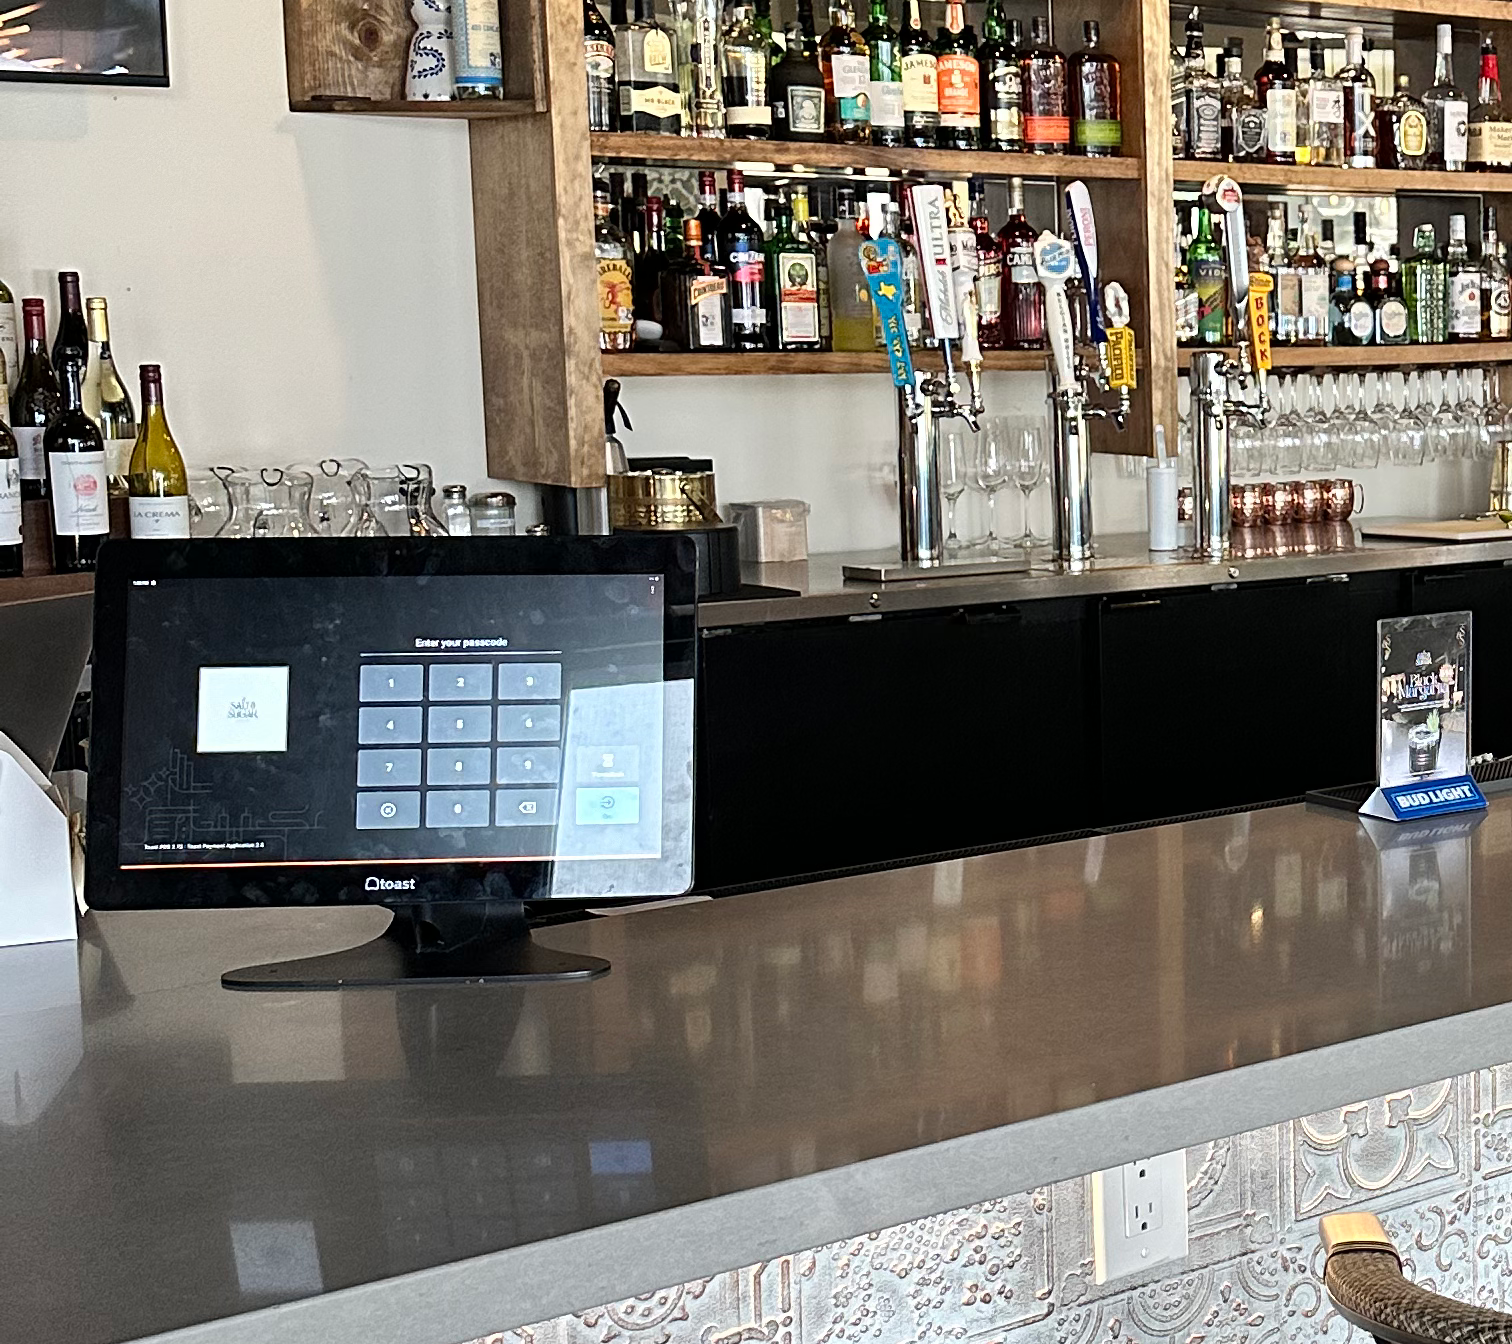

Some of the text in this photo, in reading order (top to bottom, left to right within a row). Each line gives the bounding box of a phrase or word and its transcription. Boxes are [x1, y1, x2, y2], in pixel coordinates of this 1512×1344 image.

[928, 196, 946, 258] ULTRA
[1254, 296, 1268, 363] BOCK
[415, 637, 508, 649] Enter your passcode
[1396, 785, 1473, 809] BUD LIGHT
[380, 878, 416, 890] toast
